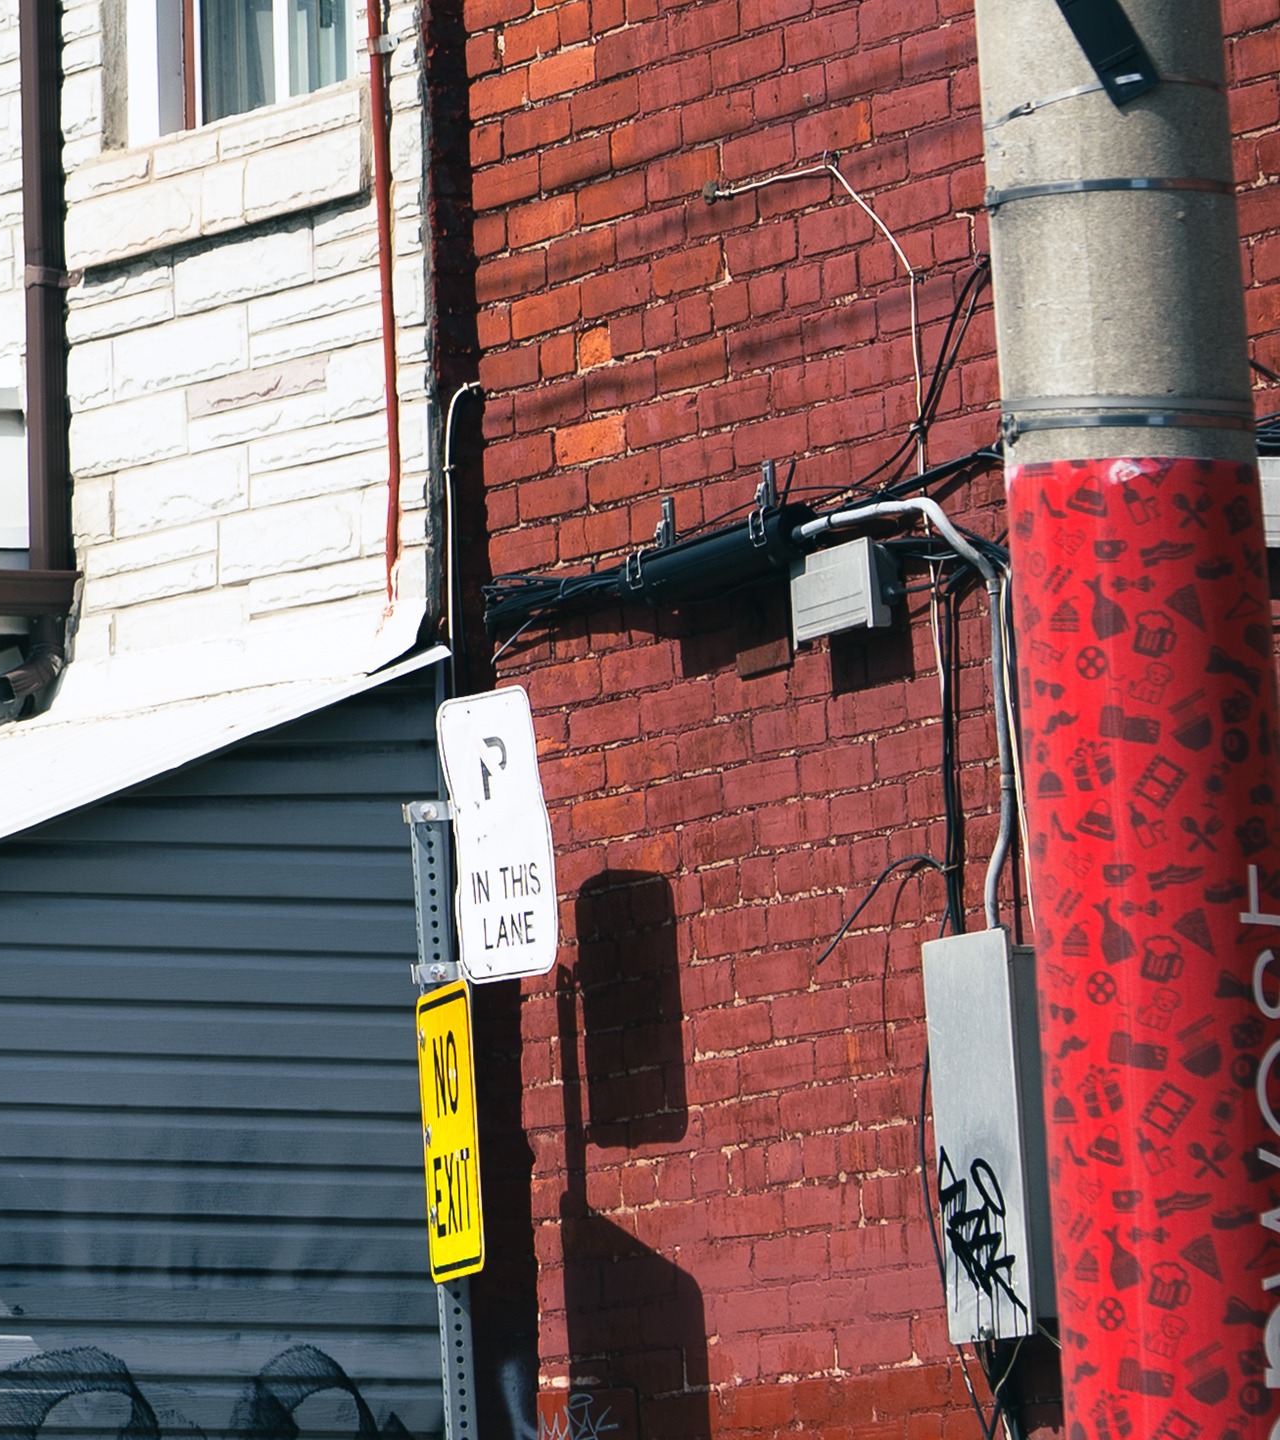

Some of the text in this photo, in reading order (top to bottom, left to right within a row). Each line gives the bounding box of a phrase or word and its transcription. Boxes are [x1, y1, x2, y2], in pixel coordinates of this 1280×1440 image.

[471, 862, 541, 905] IN THIS
[483, 911, 537, 951] LANE
[432, 1030, 459, 1119] NO
[433, 1147, 471, 1239] EXIT
